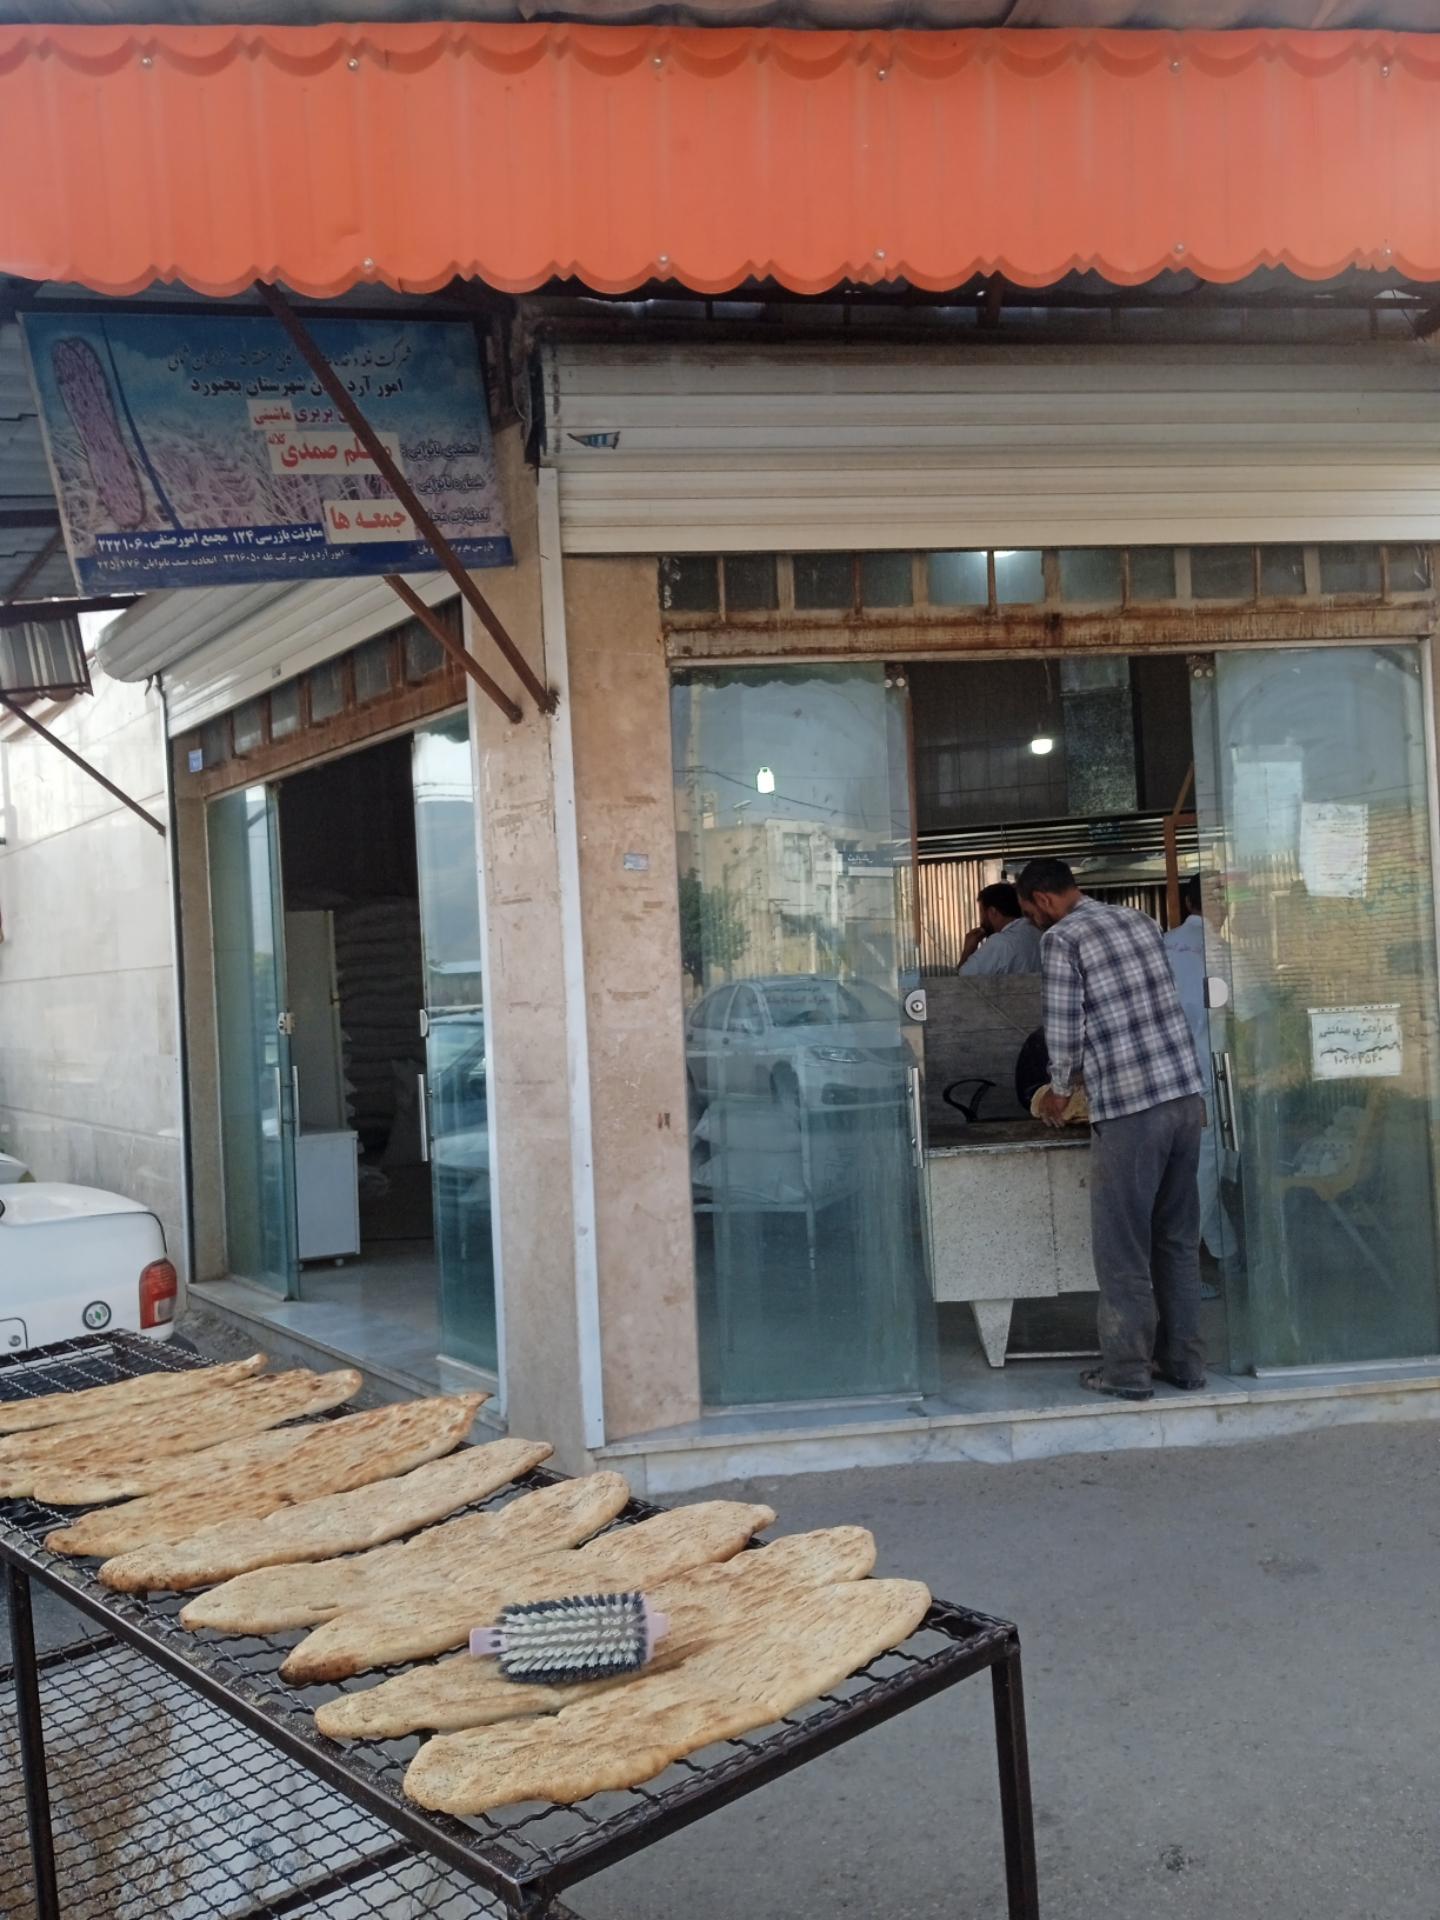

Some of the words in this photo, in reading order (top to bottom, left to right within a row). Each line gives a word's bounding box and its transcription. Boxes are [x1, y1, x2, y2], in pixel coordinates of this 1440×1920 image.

[373, 335, 411, 369] شرکت
[191, 377, 242, 397] بجنورد
[246, 376, 305, 397] شهرستان
[346, 375, 371, 397] آرد
[377, 377, 403, 397] امور
[254, 407, 291, 425] ماشینی
[294, 407, 334, 424] بربری
[281, 442, 338, 468] صمدی
[329, 507, 350, 530] ها
[356, 508, 408, 533] جمعه
[149, 533, 178, 549] صنفی
[178, 531, 199, 548] امور
[200, 532, 229, 547] مجمع
[232, 529, 255, 545] ۱۲۴
[255, 529, 291, 545] بازرسی
[291, 527, 324, 542] معاونت
